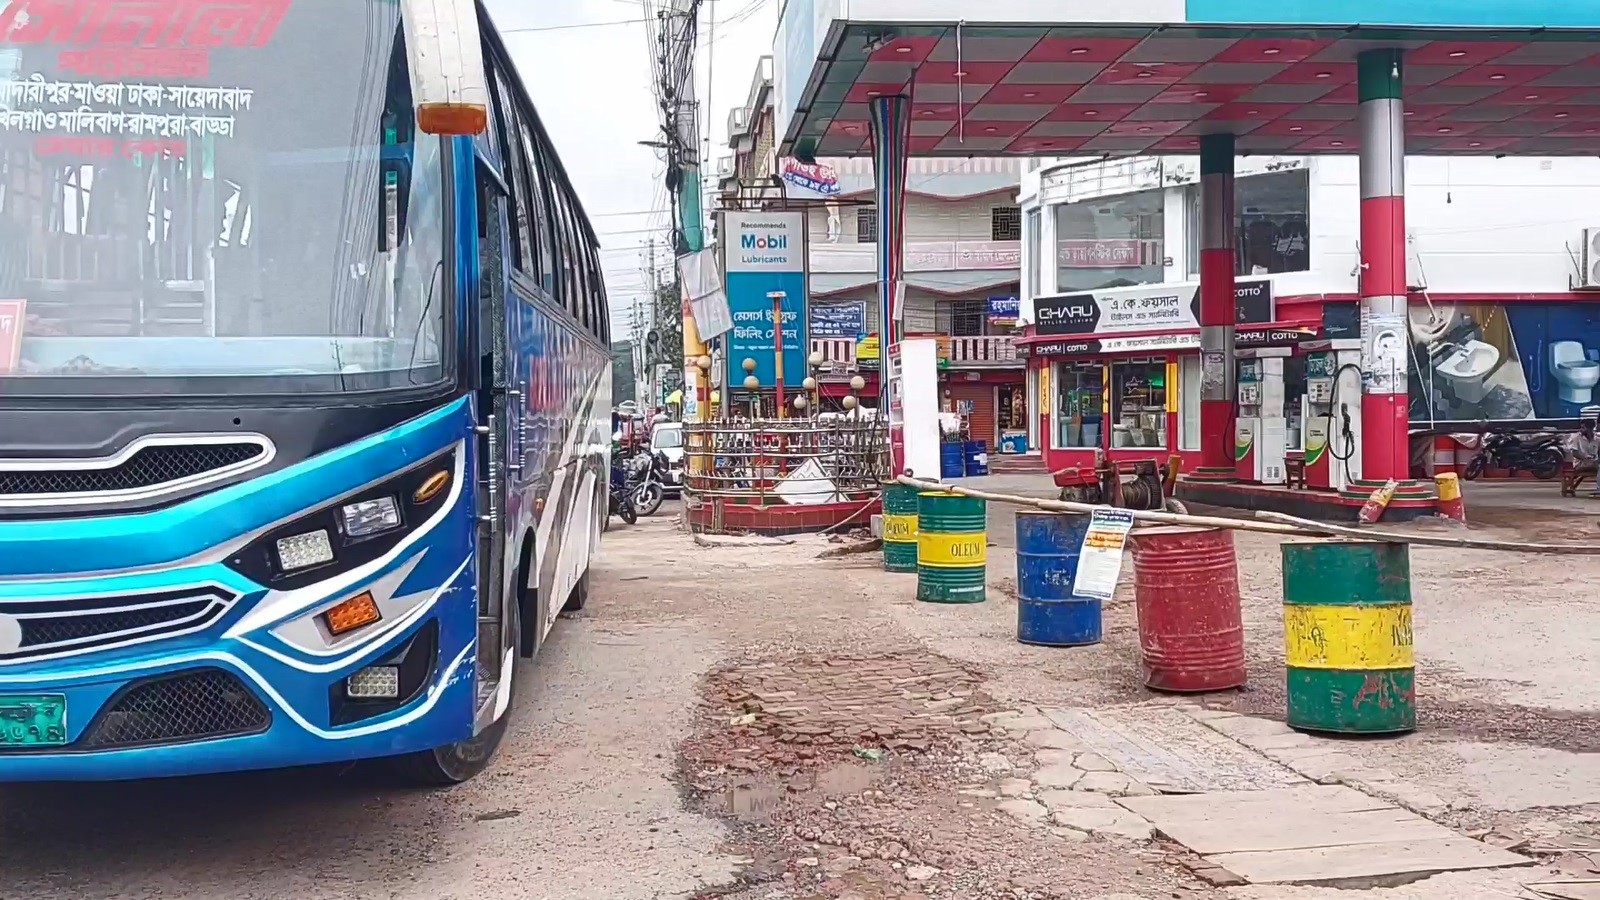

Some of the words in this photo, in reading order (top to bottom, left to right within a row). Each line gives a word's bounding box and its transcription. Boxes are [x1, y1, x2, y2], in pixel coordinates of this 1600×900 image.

[741, 234, 787, 249] Mobil
[1038, 305, 1093, 321] CHARU
[1271, 331, 1299, 340] COTTO
[1066, 343, 1089, 353] COTTO
[951, 542, 980, 557] OLEUM
